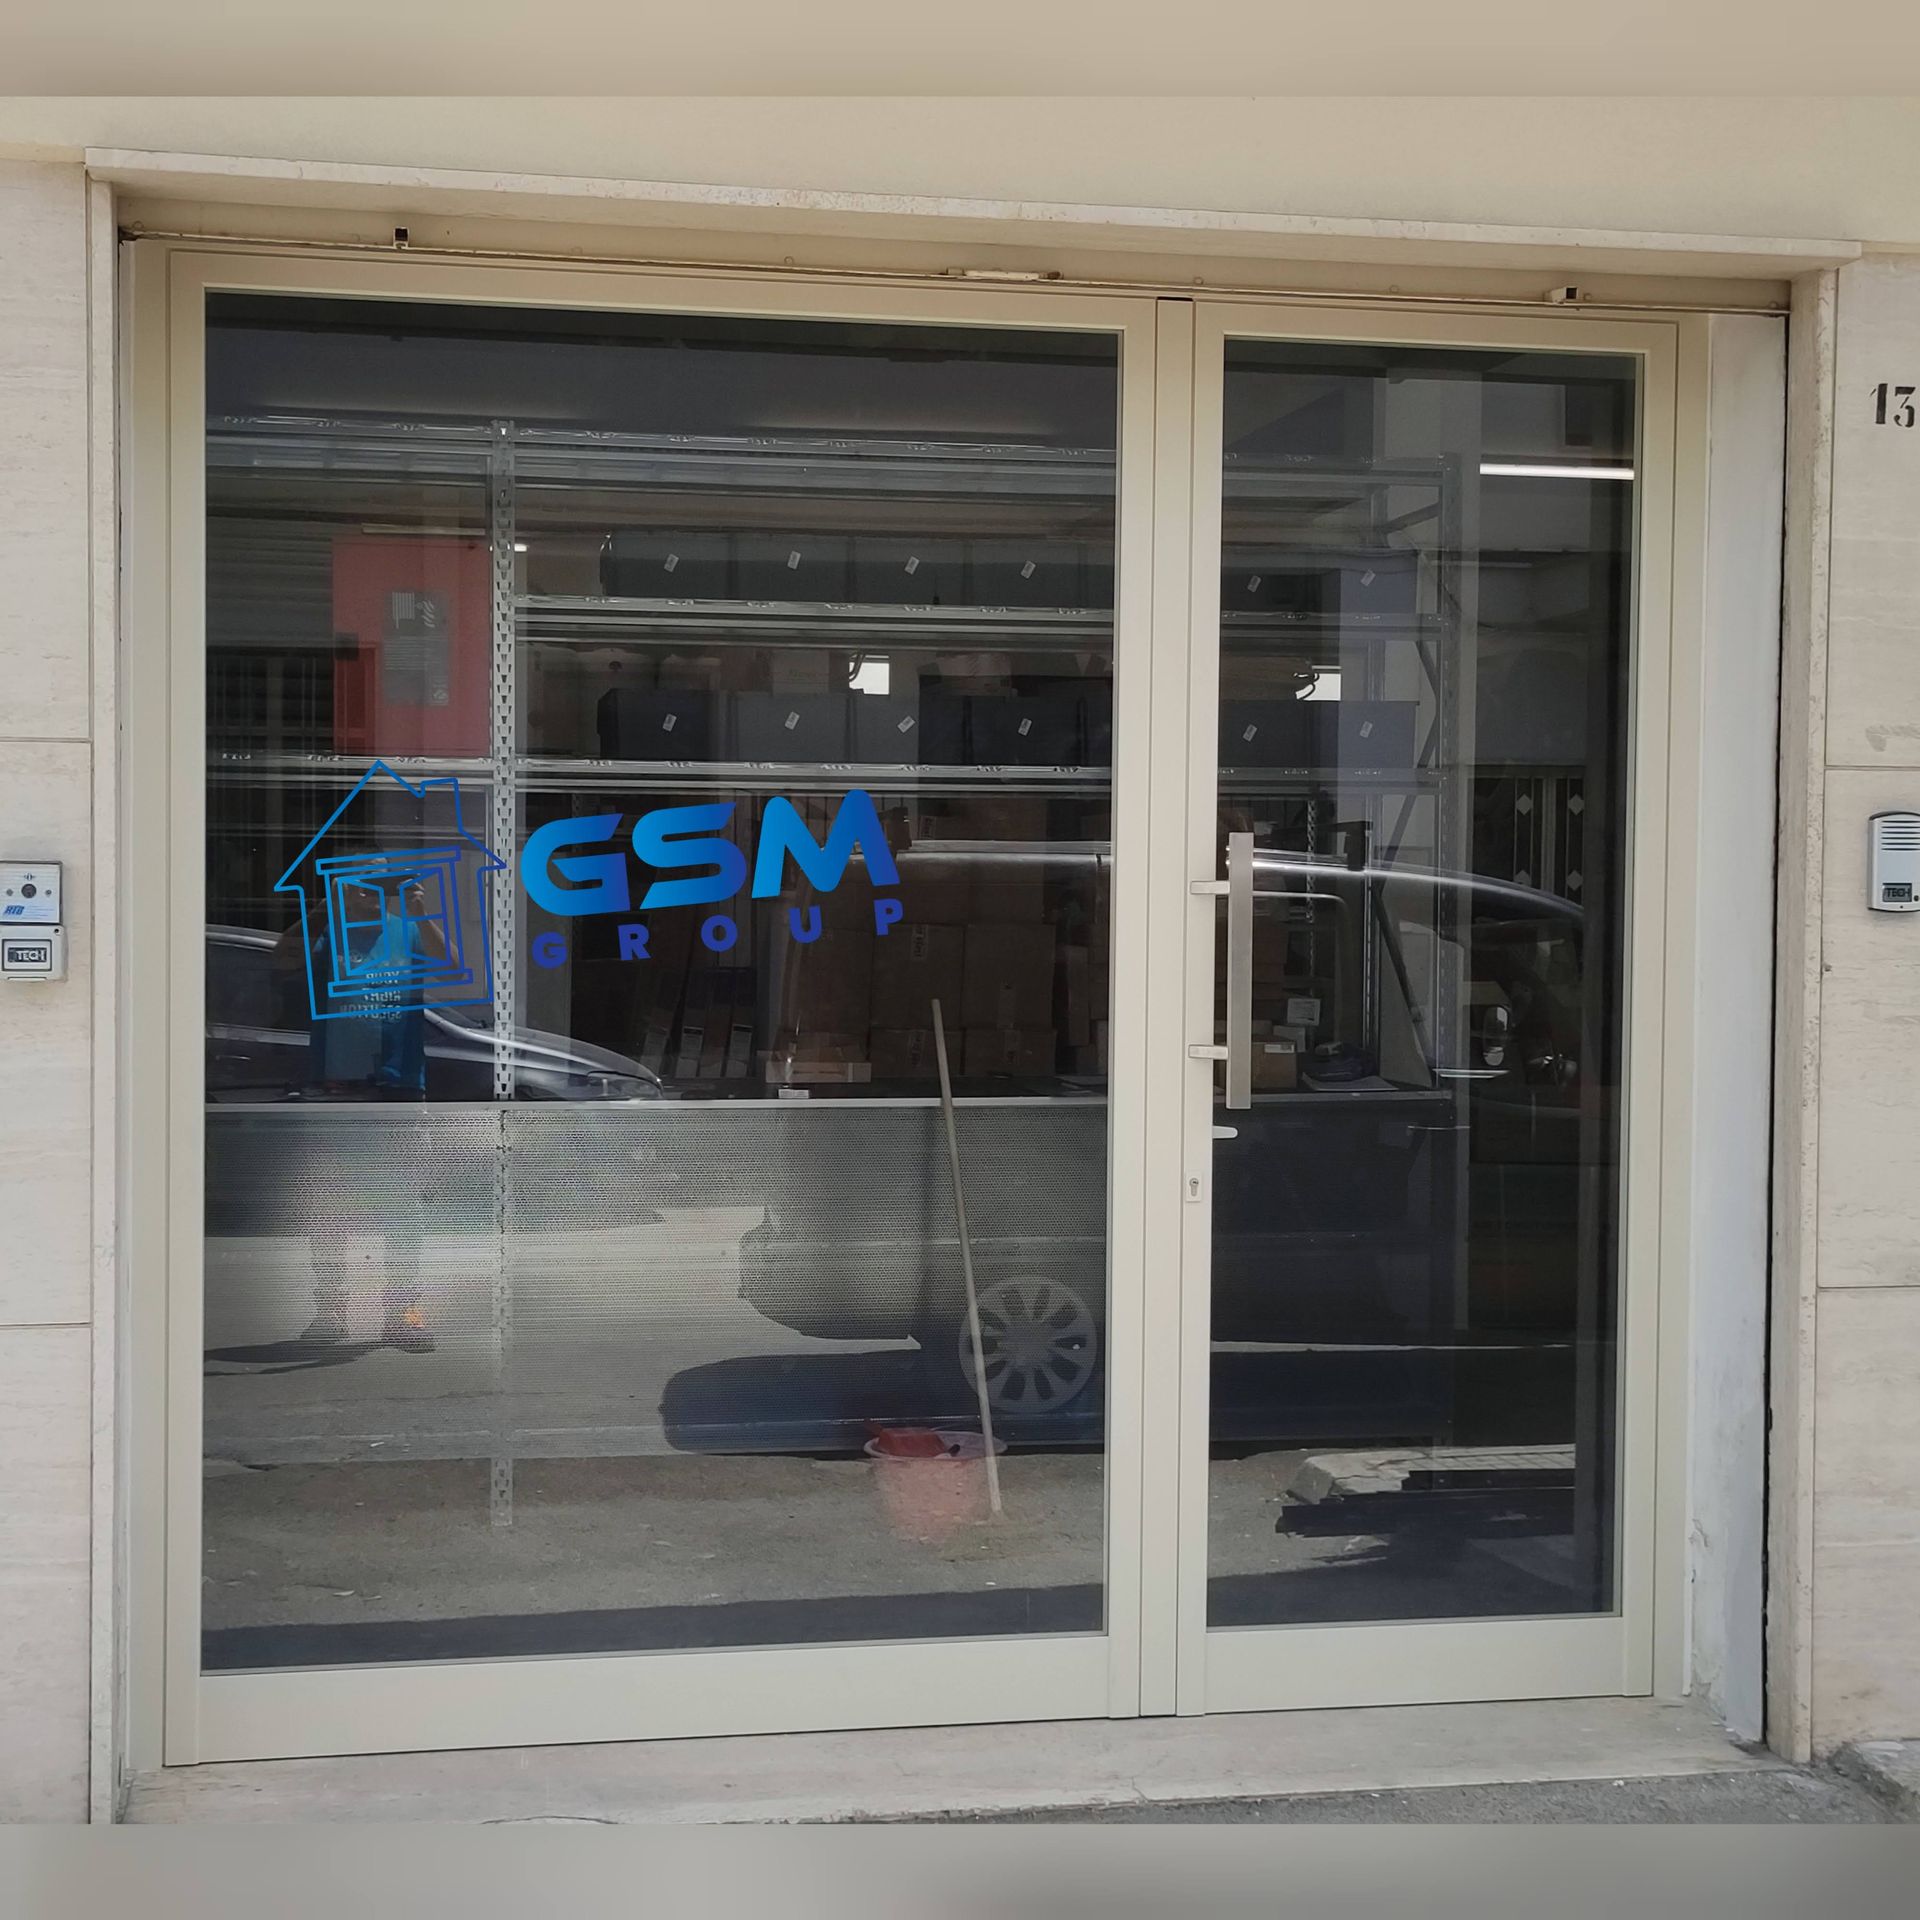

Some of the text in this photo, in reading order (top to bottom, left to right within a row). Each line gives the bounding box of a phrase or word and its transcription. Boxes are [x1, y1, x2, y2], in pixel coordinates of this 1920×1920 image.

[1869, 383, 1916, 428] 13
[521, 789, 900, 916] GSM
[532, 898, 904, 969] GROUP
